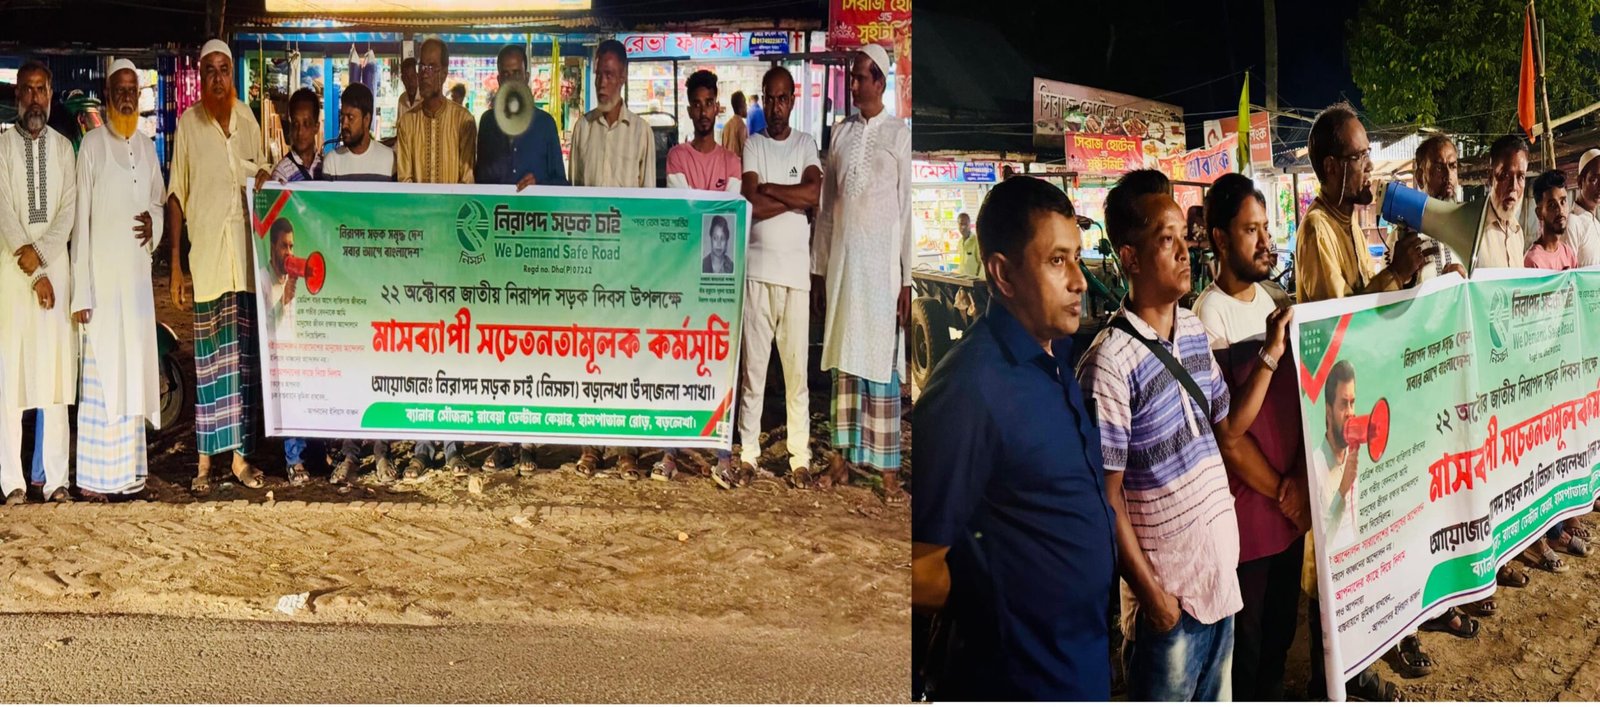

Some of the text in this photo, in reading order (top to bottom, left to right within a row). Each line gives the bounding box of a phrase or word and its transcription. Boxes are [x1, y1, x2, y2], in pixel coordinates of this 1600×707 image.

[1074, 133, 1136, 152] সিরাজ হোটেল
[494, 204, 622, 236] নিরাপদ সড়ক চাই
[367, 227, 386, 240] সড়ক
[408, 229, 424, 242] দেশ
[342, 247, 360, 258] সবার
[363, 247, 382, 258] আগে
[459, 251, 486, 266] নিসচা
[494, 242, 620, 261] We Demand Safe Road
[523, 265, 539, 274] Regd
[381, 279, 684, 310] ২২ অক্টোবর জাতীয় নিরাপদ সড়ক দিবস উপলক্ষে
[1512, 289, 1540, 322] নিরাপদ
[371, 307, 730, 377] মাসব্যাপী সচেতনতামূলক কর্মসূচি
[1513, 332, 1523, 349] We
[436, 369, 478, 395] নিরাপদ
[480, 378, 510, 400] সড়ক
[513, 375, 533, 399] চাই
[536, 372, 579, 398] (নিসচা)
[582, 381, 627, 403] বড়লেখা
[630, 376, 680, 400] উপজেলা
[683, 384, 715, 401] শাখা।
[1406, 373, 1422, 391] সবার
[1436, 408, 1453, 436] ২২
[1489, 378, 1517, 409] জাতীয়
[1517, 374, 1544, 401] নিরাপদ
[1544, 368, 1559, 391] সড়ক
[1560, 359, 1581, 383] দিবস
[405, 407, 435, 423] ব্যানার
[476, 409, 505, 425] রাবেয়া
[508, 408, 541, 425] ডেন্টাল
[578, 411, 626, 428] হাসপাতাল
[1504, 483, 1522, 512] সড়ক
[1523, 470, 1534, 498] চাই
